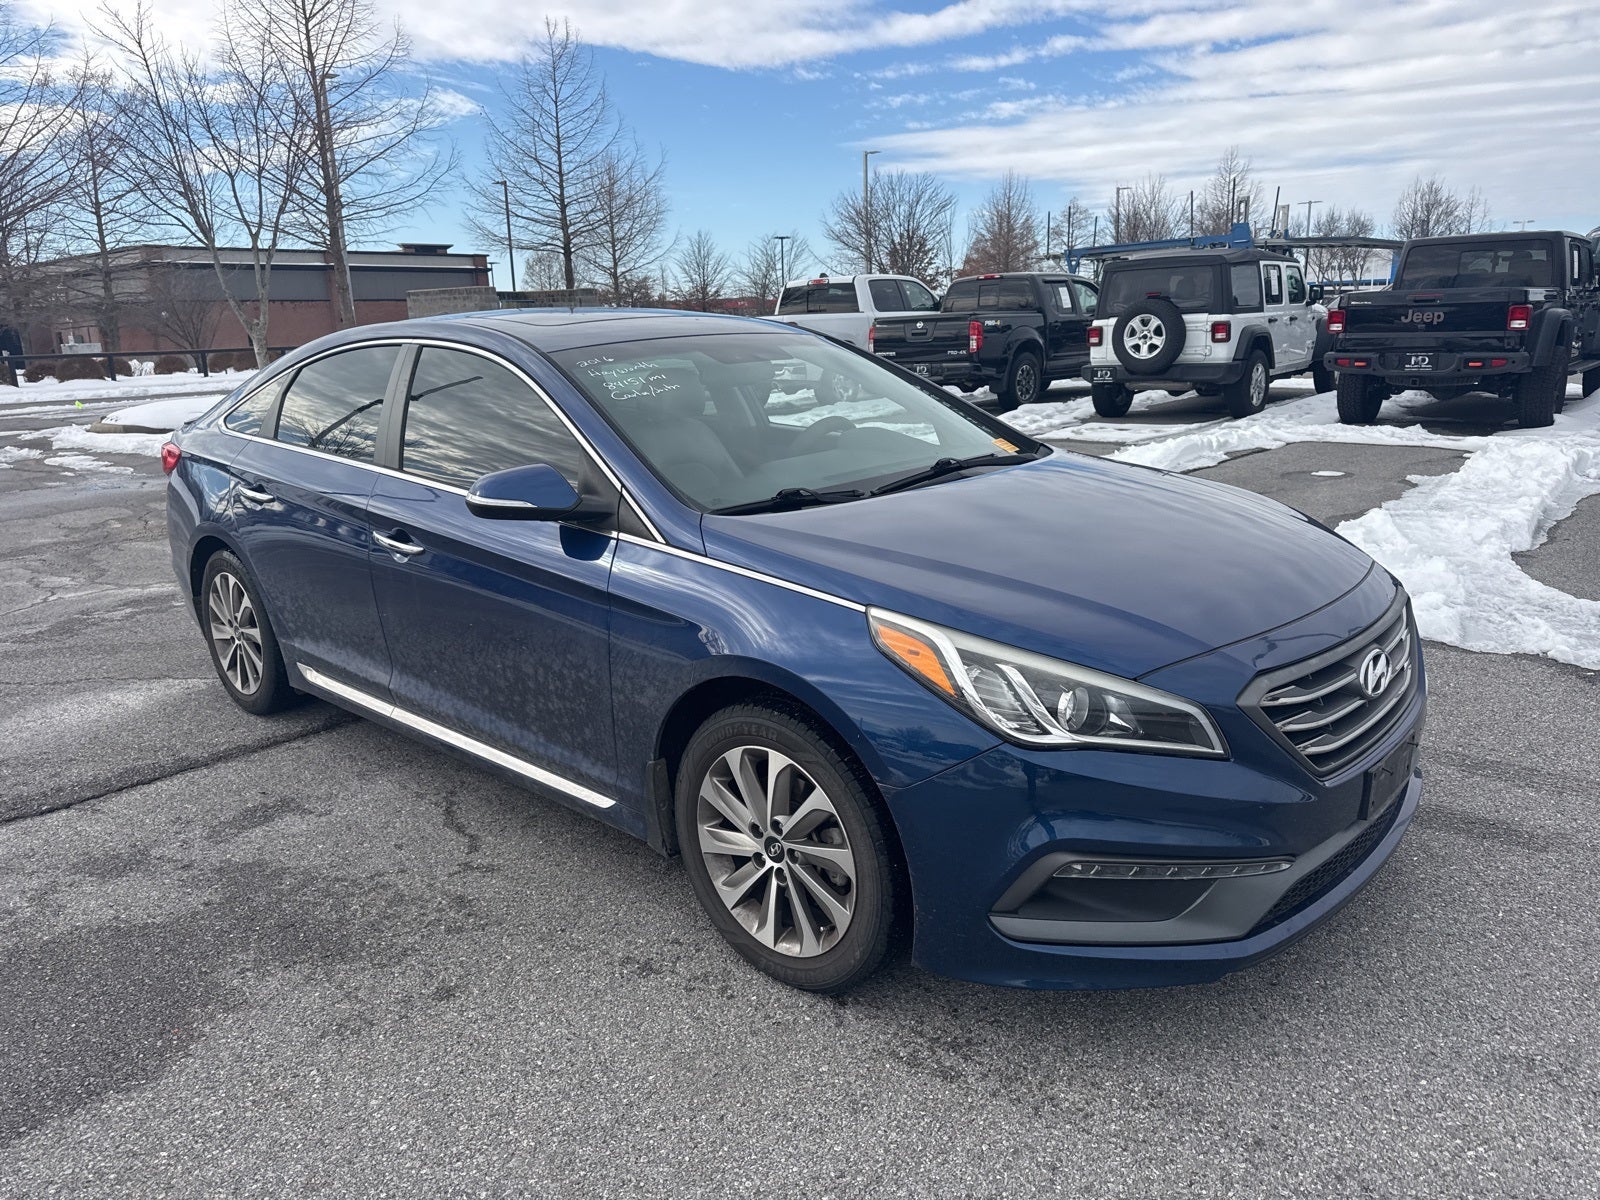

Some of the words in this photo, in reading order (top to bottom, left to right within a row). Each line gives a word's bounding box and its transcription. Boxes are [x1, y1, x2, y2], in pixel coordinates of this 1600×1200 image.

[1400, 309, 1445, 325] Jeep
[576, 356, 614, 368] 2016
[704, 722, 777, 748] GOODYEAR
